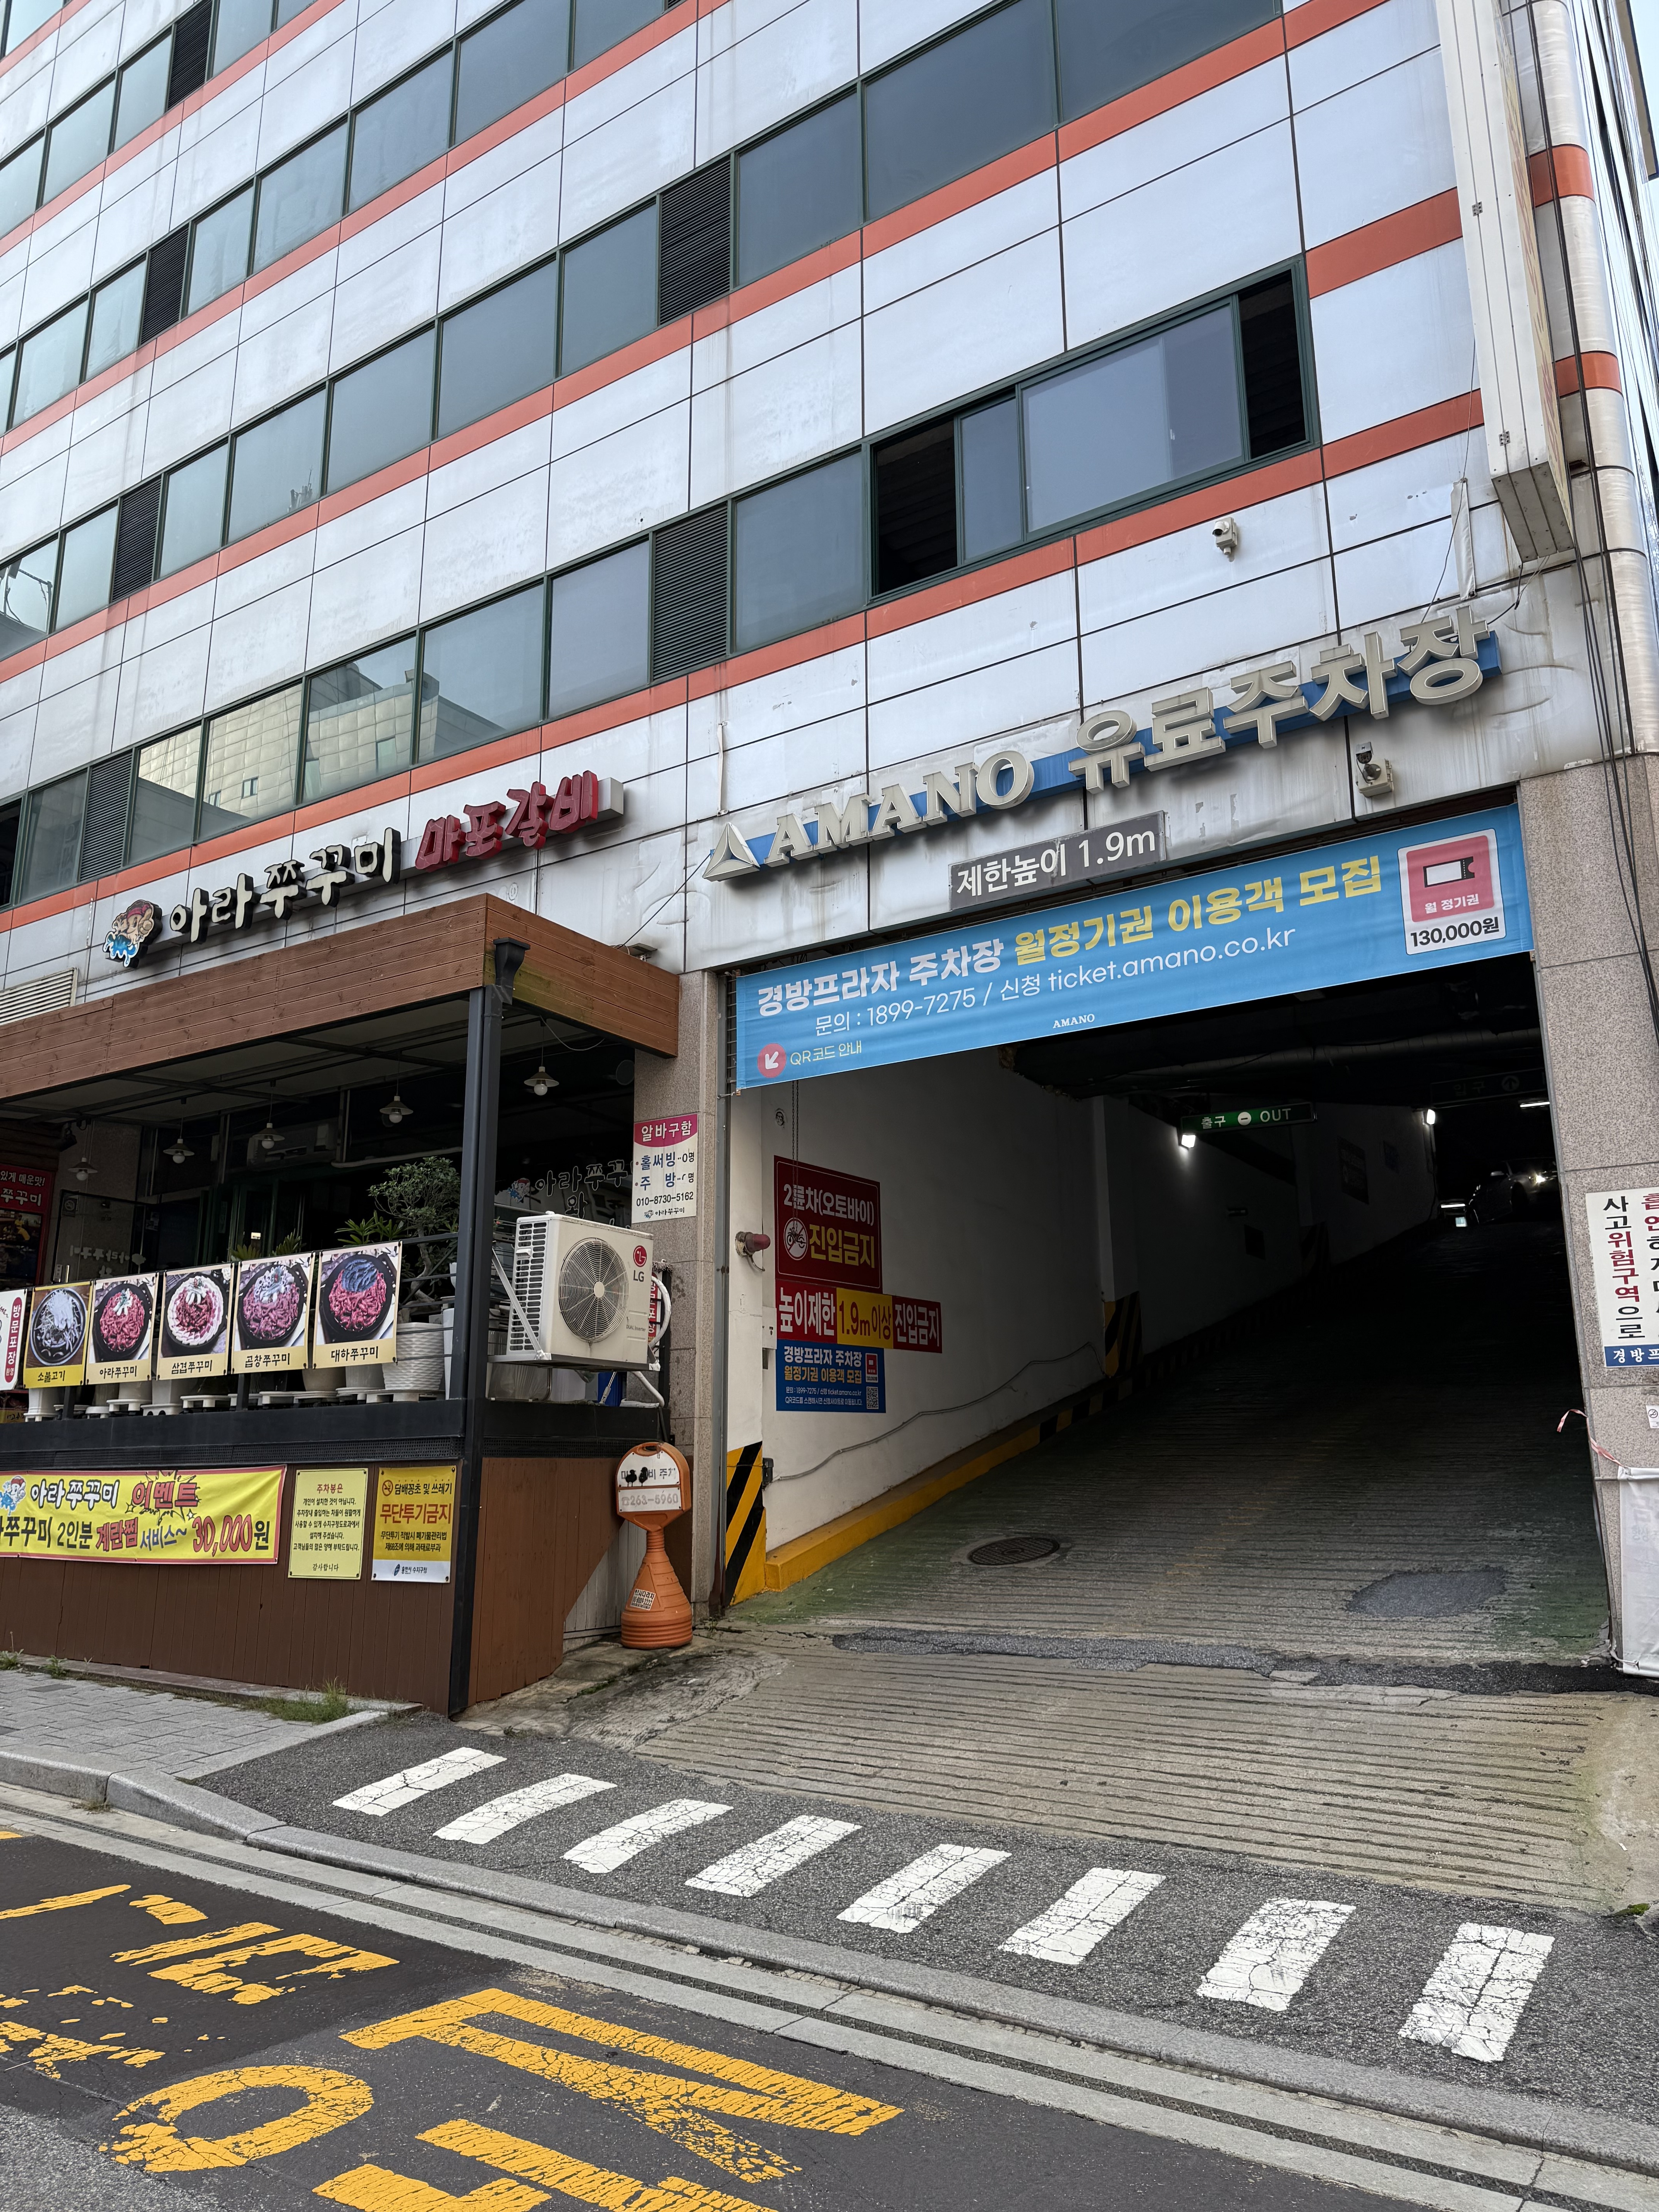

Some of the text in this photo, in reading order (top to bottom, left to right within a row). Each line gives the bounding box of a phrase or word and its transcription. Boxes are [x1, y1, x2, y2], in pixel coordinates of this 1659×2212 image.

[764, 605, 1490, 867] AMANO 유료주차장
[170, 827, 401, 944] 아라쭈꾸미
[415, 771, 598, 872] 마포갈비
[957, 827, 1156, 896] 제한높이 1.9m
[1425, 894, 1479, 914] 월 정기권
[758, 855, 1382, 1017] 경방프라자 주차장 월정기권 이용객 모집
[1410, 917, 1499, 947] 130,000원
[816, 1011, 850, 1037] 문의
[867, 988, 975, 1026] 1899-7275
[1001, 974, 1041, 1002] 신청
[1048, 926, 1297, 994] ticket.amano.co.kr
[1053, 1014, 1096, 1029] AMANO
[790, 1041, 862, 1066] QR코드 안내
[1201, 1108, 1291, 1130] 출구 OUT
[641, 1120, 692, 1142] 알바구함
[0, 1171, 45, 1187] 있게 매운맛!
[535, 1159, 633, 1197] 아라쭈꾸
[0, 1188, 41, 1206] 쭈꾸미
[636, 1192, 694, 1207] 010-8730-5162
[783, 1184, 874, 1226] 2륜차(오토바이)
[655, 1207, 685, 1216] 아라쭈꾸미
[809, 1224, 875, 1268] 진입금지
[633, 1270, 644, 1283] LG
[779, 1287, 835, 1336] 높이제한
[895, 1303, 939, 1347] 진입금지
[8, 1305, 22, 1366] 방문포장
[245, 1353, 290, 1368] 곱창쭈꾸미
[331, 1346, 379, 1363] 대하쭈꾸미
[784, 1346, 862, 1367] 경방프라자 주차장
[38, 1370, 65, 1381] 소불고기
[100, 1365, 137, 1379] 아라쭈꾸미
[171, 1360, 213, 1375] 삼겹쭈꾸미
[784, 1365, 862, 1384] 월정기권 이용객 모집
[31, 1478, 199, 1511] 아라쭈꾸미 이벤트
[317, 1484, 343, 1494] 주차봉은
[395, 1483, 452, 1495] 담배꽁초 및 쓰레기
[380, 1503, 452, 1524] 무단투기금지
[0, 1516, 51, 1548] 쭈꾸미
[57, 1521, 93, 1549] 2인분
[95, 1516, 139, 1552] 계란찜
[193, 1514, 270, 1557] 30,000원
[381, 1531, 399, 1540] 무단투기
[400, 1531, 415, 1540] 적발시
[405, 1543, 414, 1552] 의해
[416, 1543, 441, 1552] 과태료부과
[313, 1563, 339, 1571] 감사합니다
